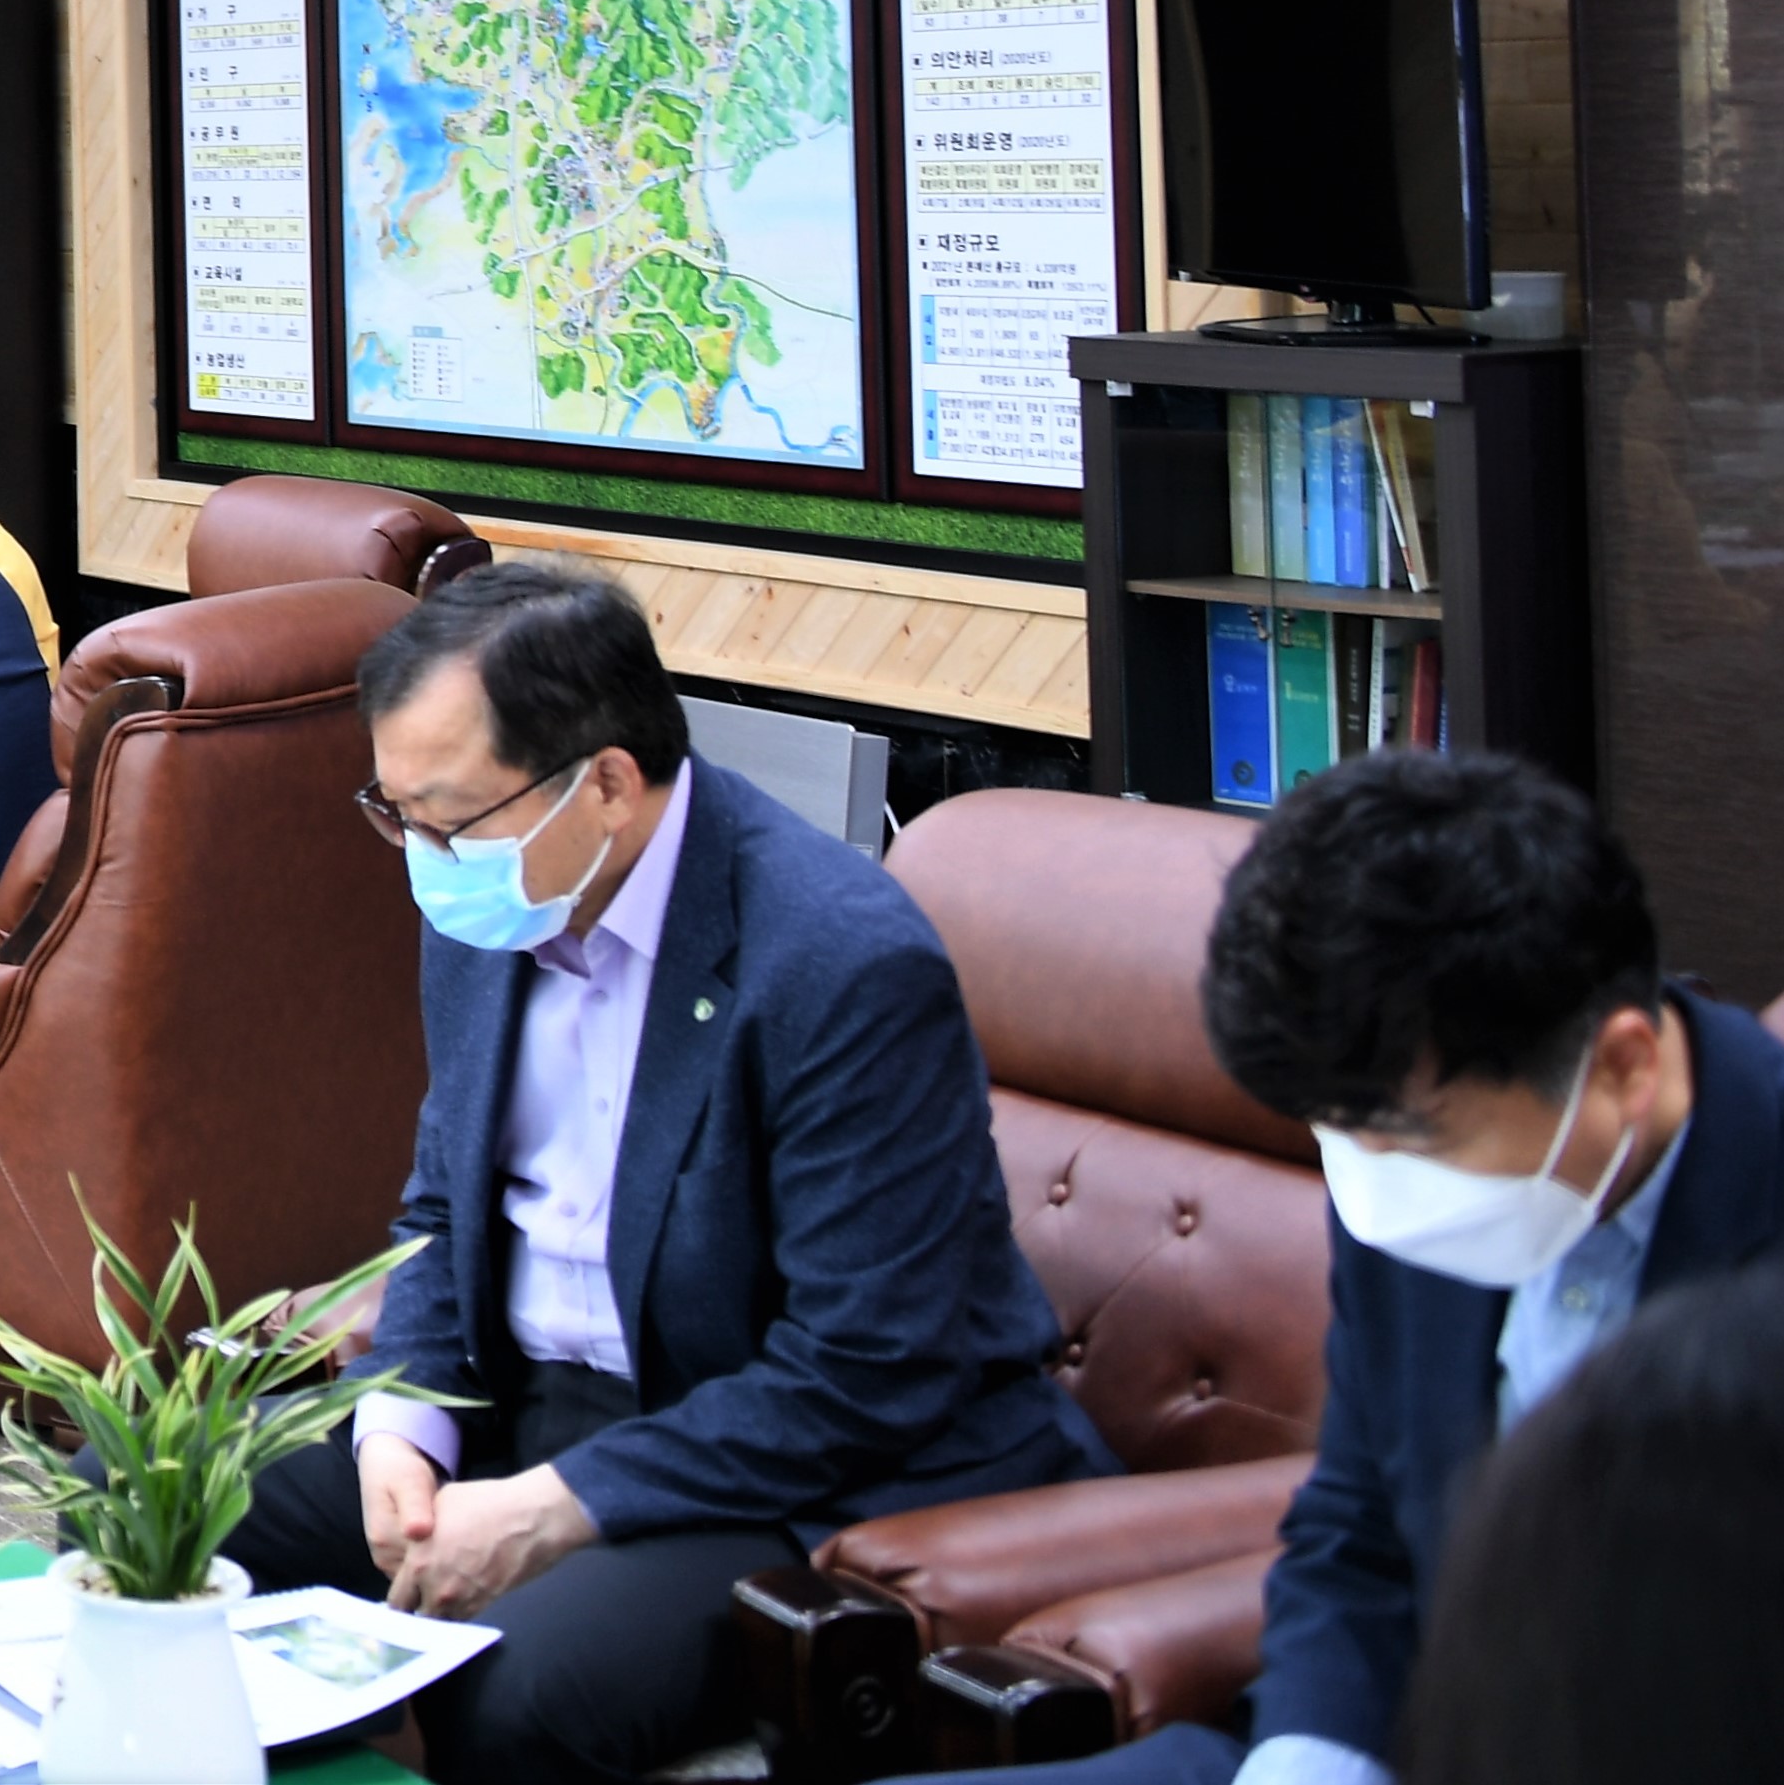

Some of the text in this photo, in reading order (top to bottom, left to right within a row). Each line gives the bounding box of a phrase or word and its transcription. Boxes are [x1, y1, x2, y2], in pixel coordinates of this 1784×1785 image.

[931, 49, 994, 69] 의안처리
[934, 132, 1013, 153] 위원회운영
[937, 233, 1000, 252] 재정규모
